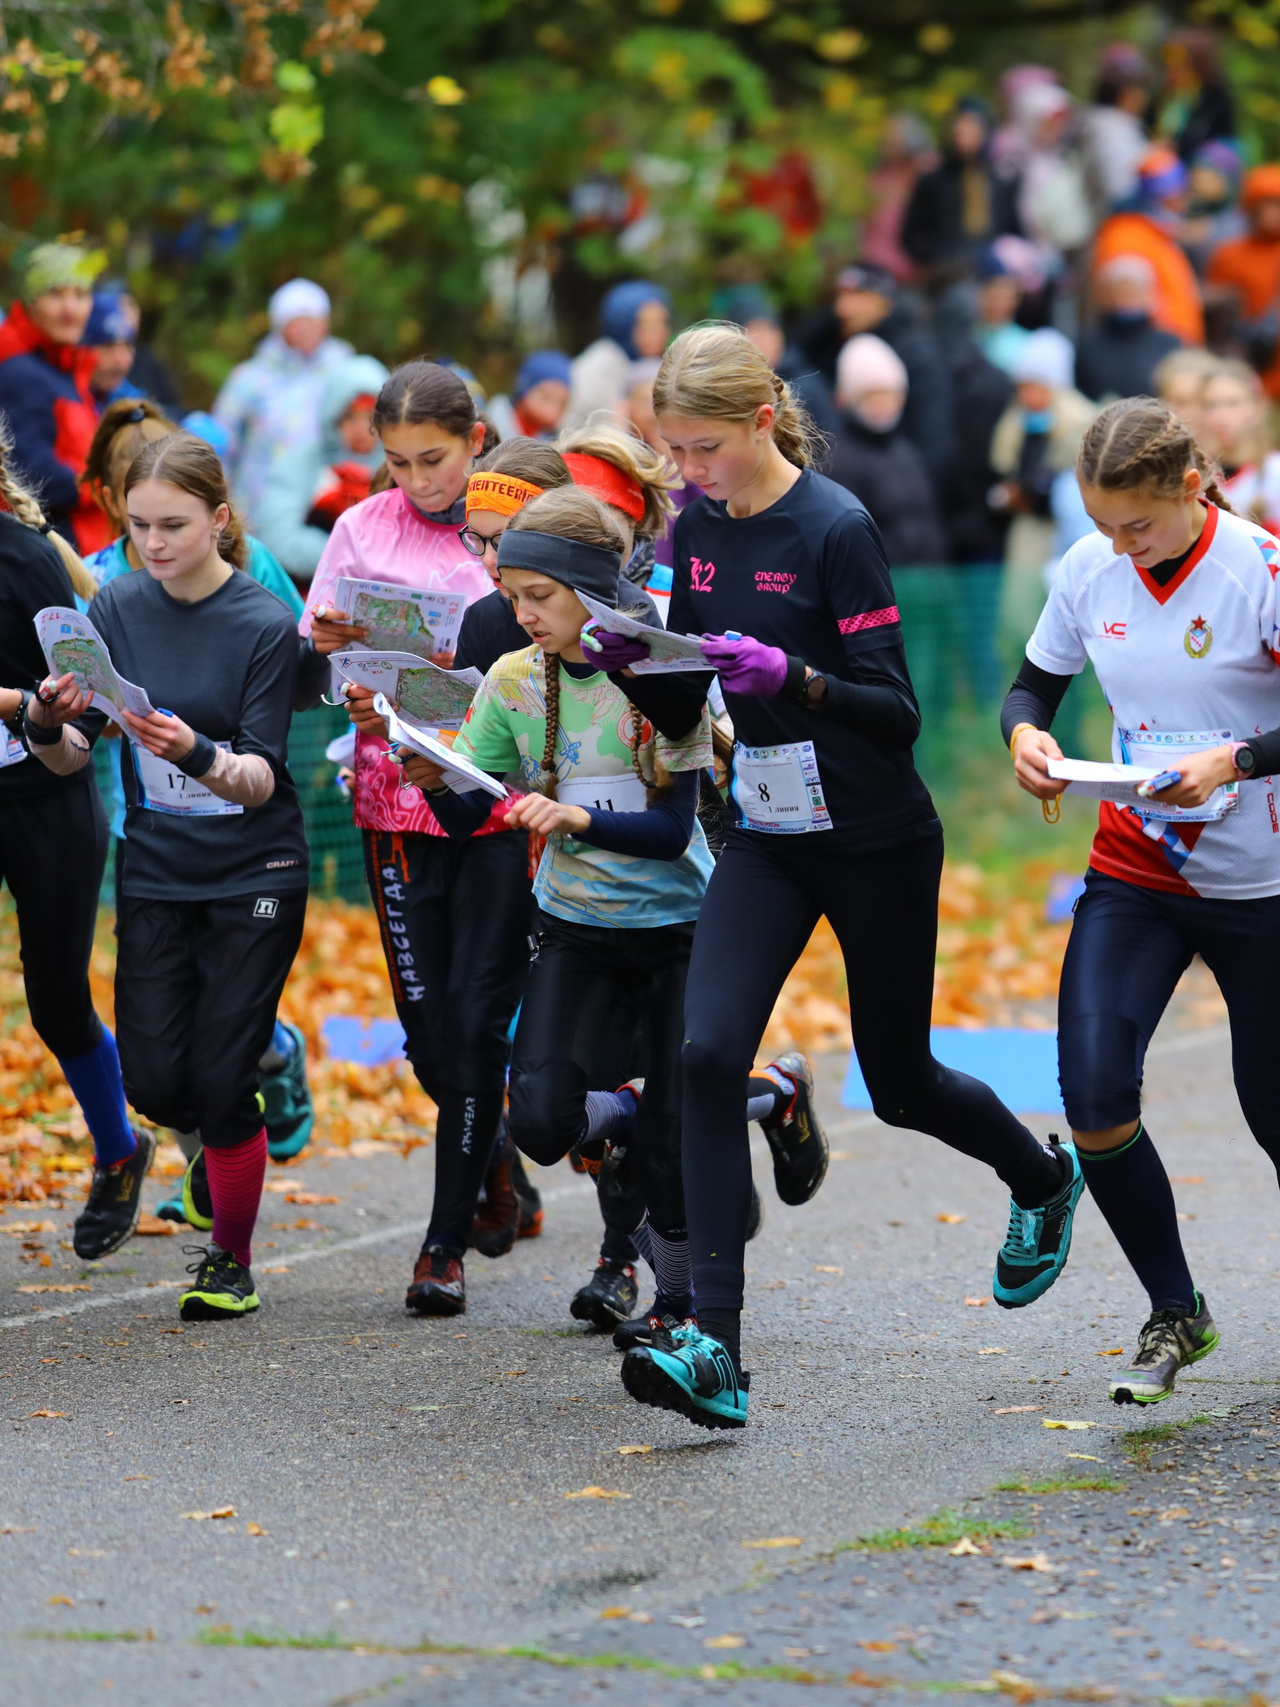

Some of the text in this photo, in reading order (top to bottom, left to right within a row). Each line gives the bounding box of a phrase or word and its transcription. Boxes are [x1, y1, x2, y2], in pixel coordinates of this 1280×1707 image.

[166, 772, 188, 791] 17
[757, 782, 771, 803] 8
[594, 799, 615, 812] 11
[775, 805, 800, 814] линия
[1267, 792, 1280, 834] CODE
[381, 865, 426, 1002] НАВСЕГДА
